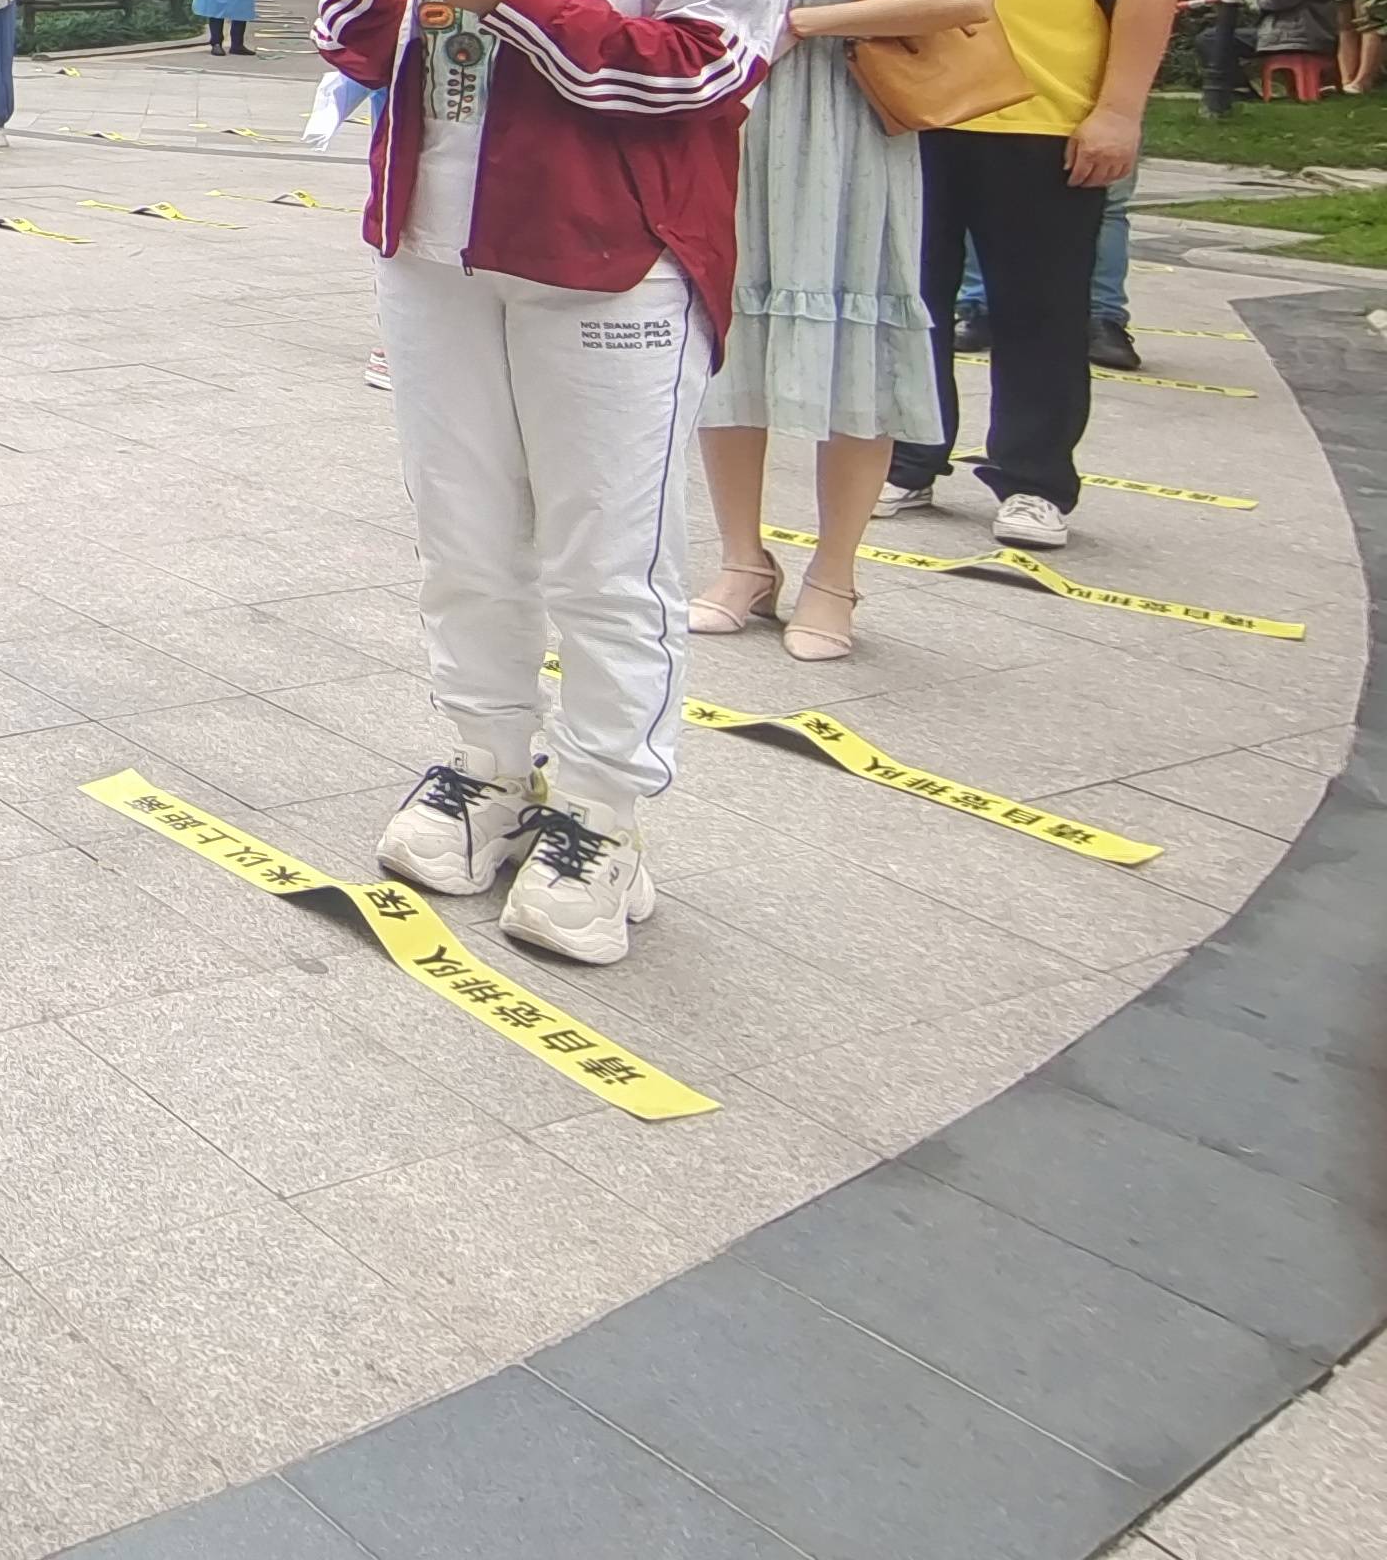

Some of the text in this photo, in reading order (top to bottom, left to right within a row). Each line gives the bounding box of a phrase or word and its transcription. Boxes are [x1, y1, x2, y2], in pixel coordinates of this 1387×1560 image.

[580, 319, 671, 330] NOI SIAMO FILA
[581, 329, 671, 340] NOI SIAMO FILA
[582, 340, 672, 350] NOI SIAMO FILA
[123, 794, 647, 1086] 请自觉排队 保米以上距离
